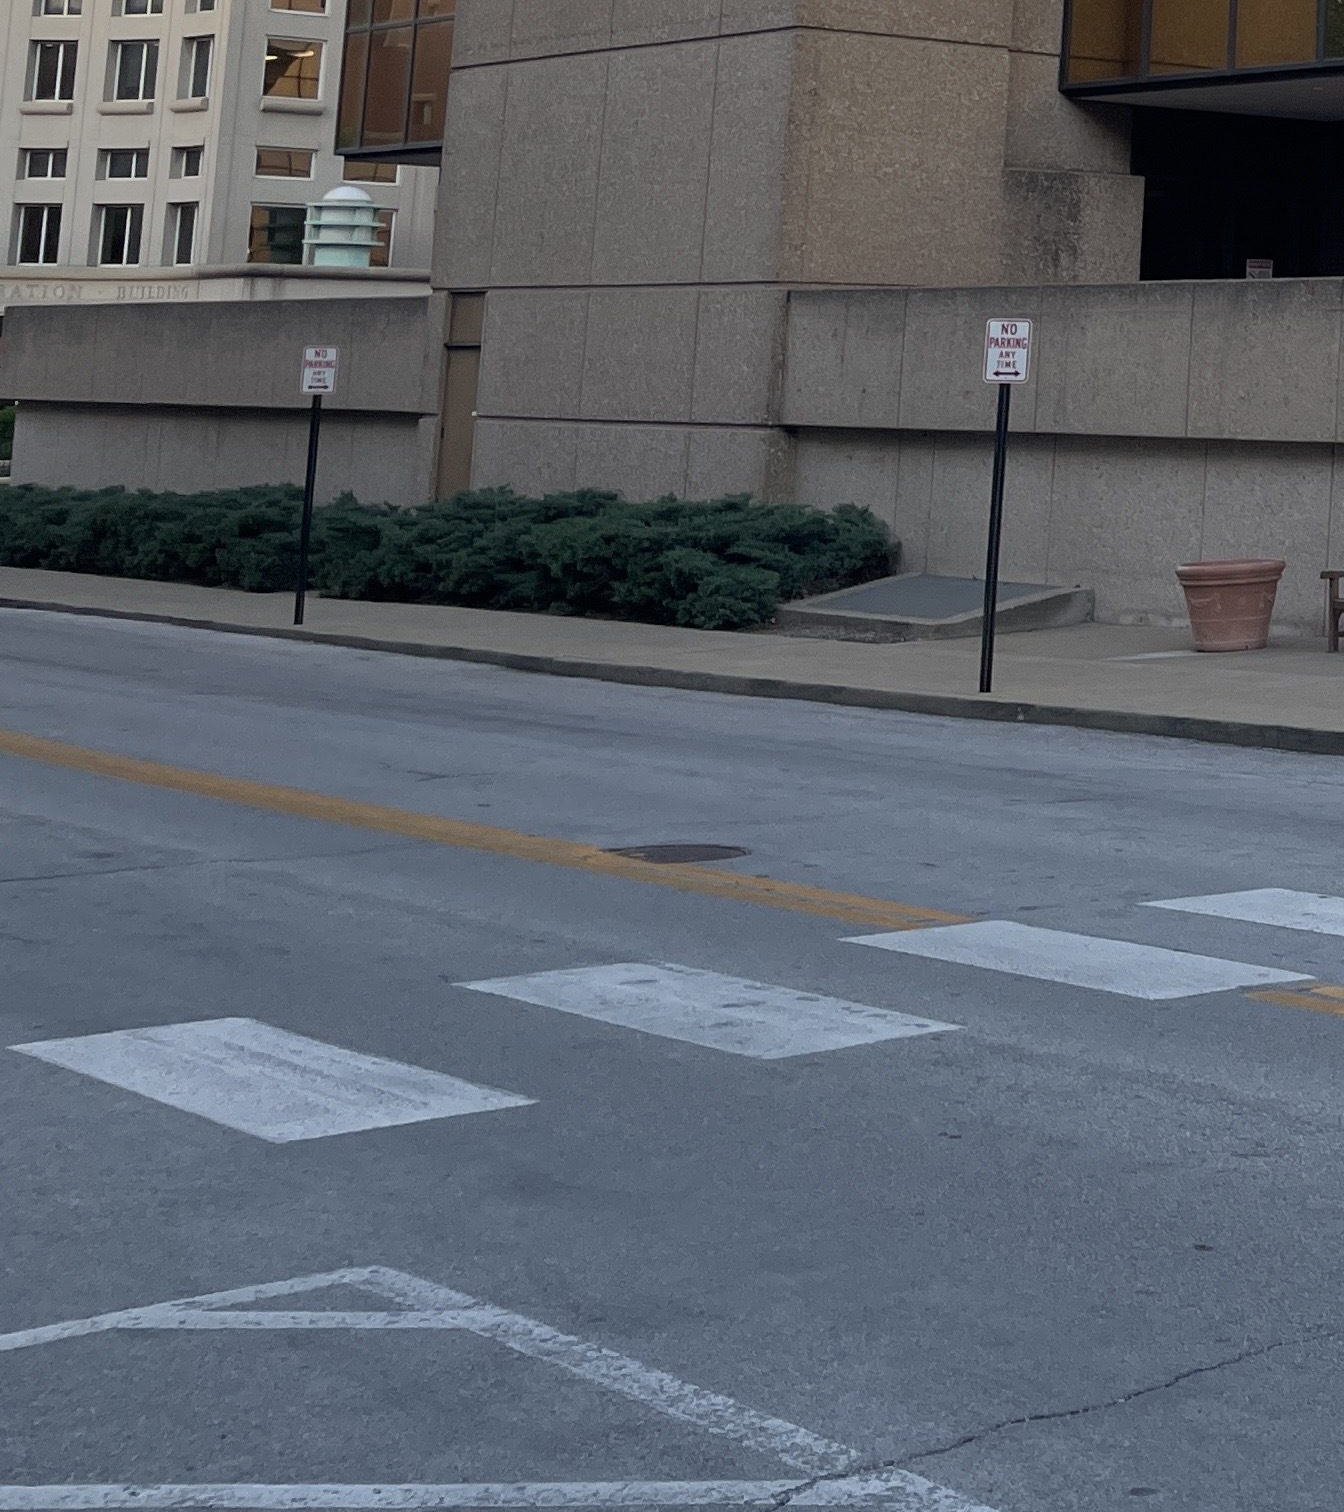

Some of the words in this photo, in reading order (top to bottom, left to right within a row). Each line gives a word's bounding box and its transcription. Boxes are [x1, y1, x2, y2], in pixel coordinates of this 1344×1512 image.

[117, 285, 189, 300] BUILDING
[1001, 323, 1017, 335] NO
[989, 337, 1028, 349] PARKING
[314, 349, 328, 359] NO
[999, 350, 1016, 359] ANY
[996, 360, 1017, 369] TIME
